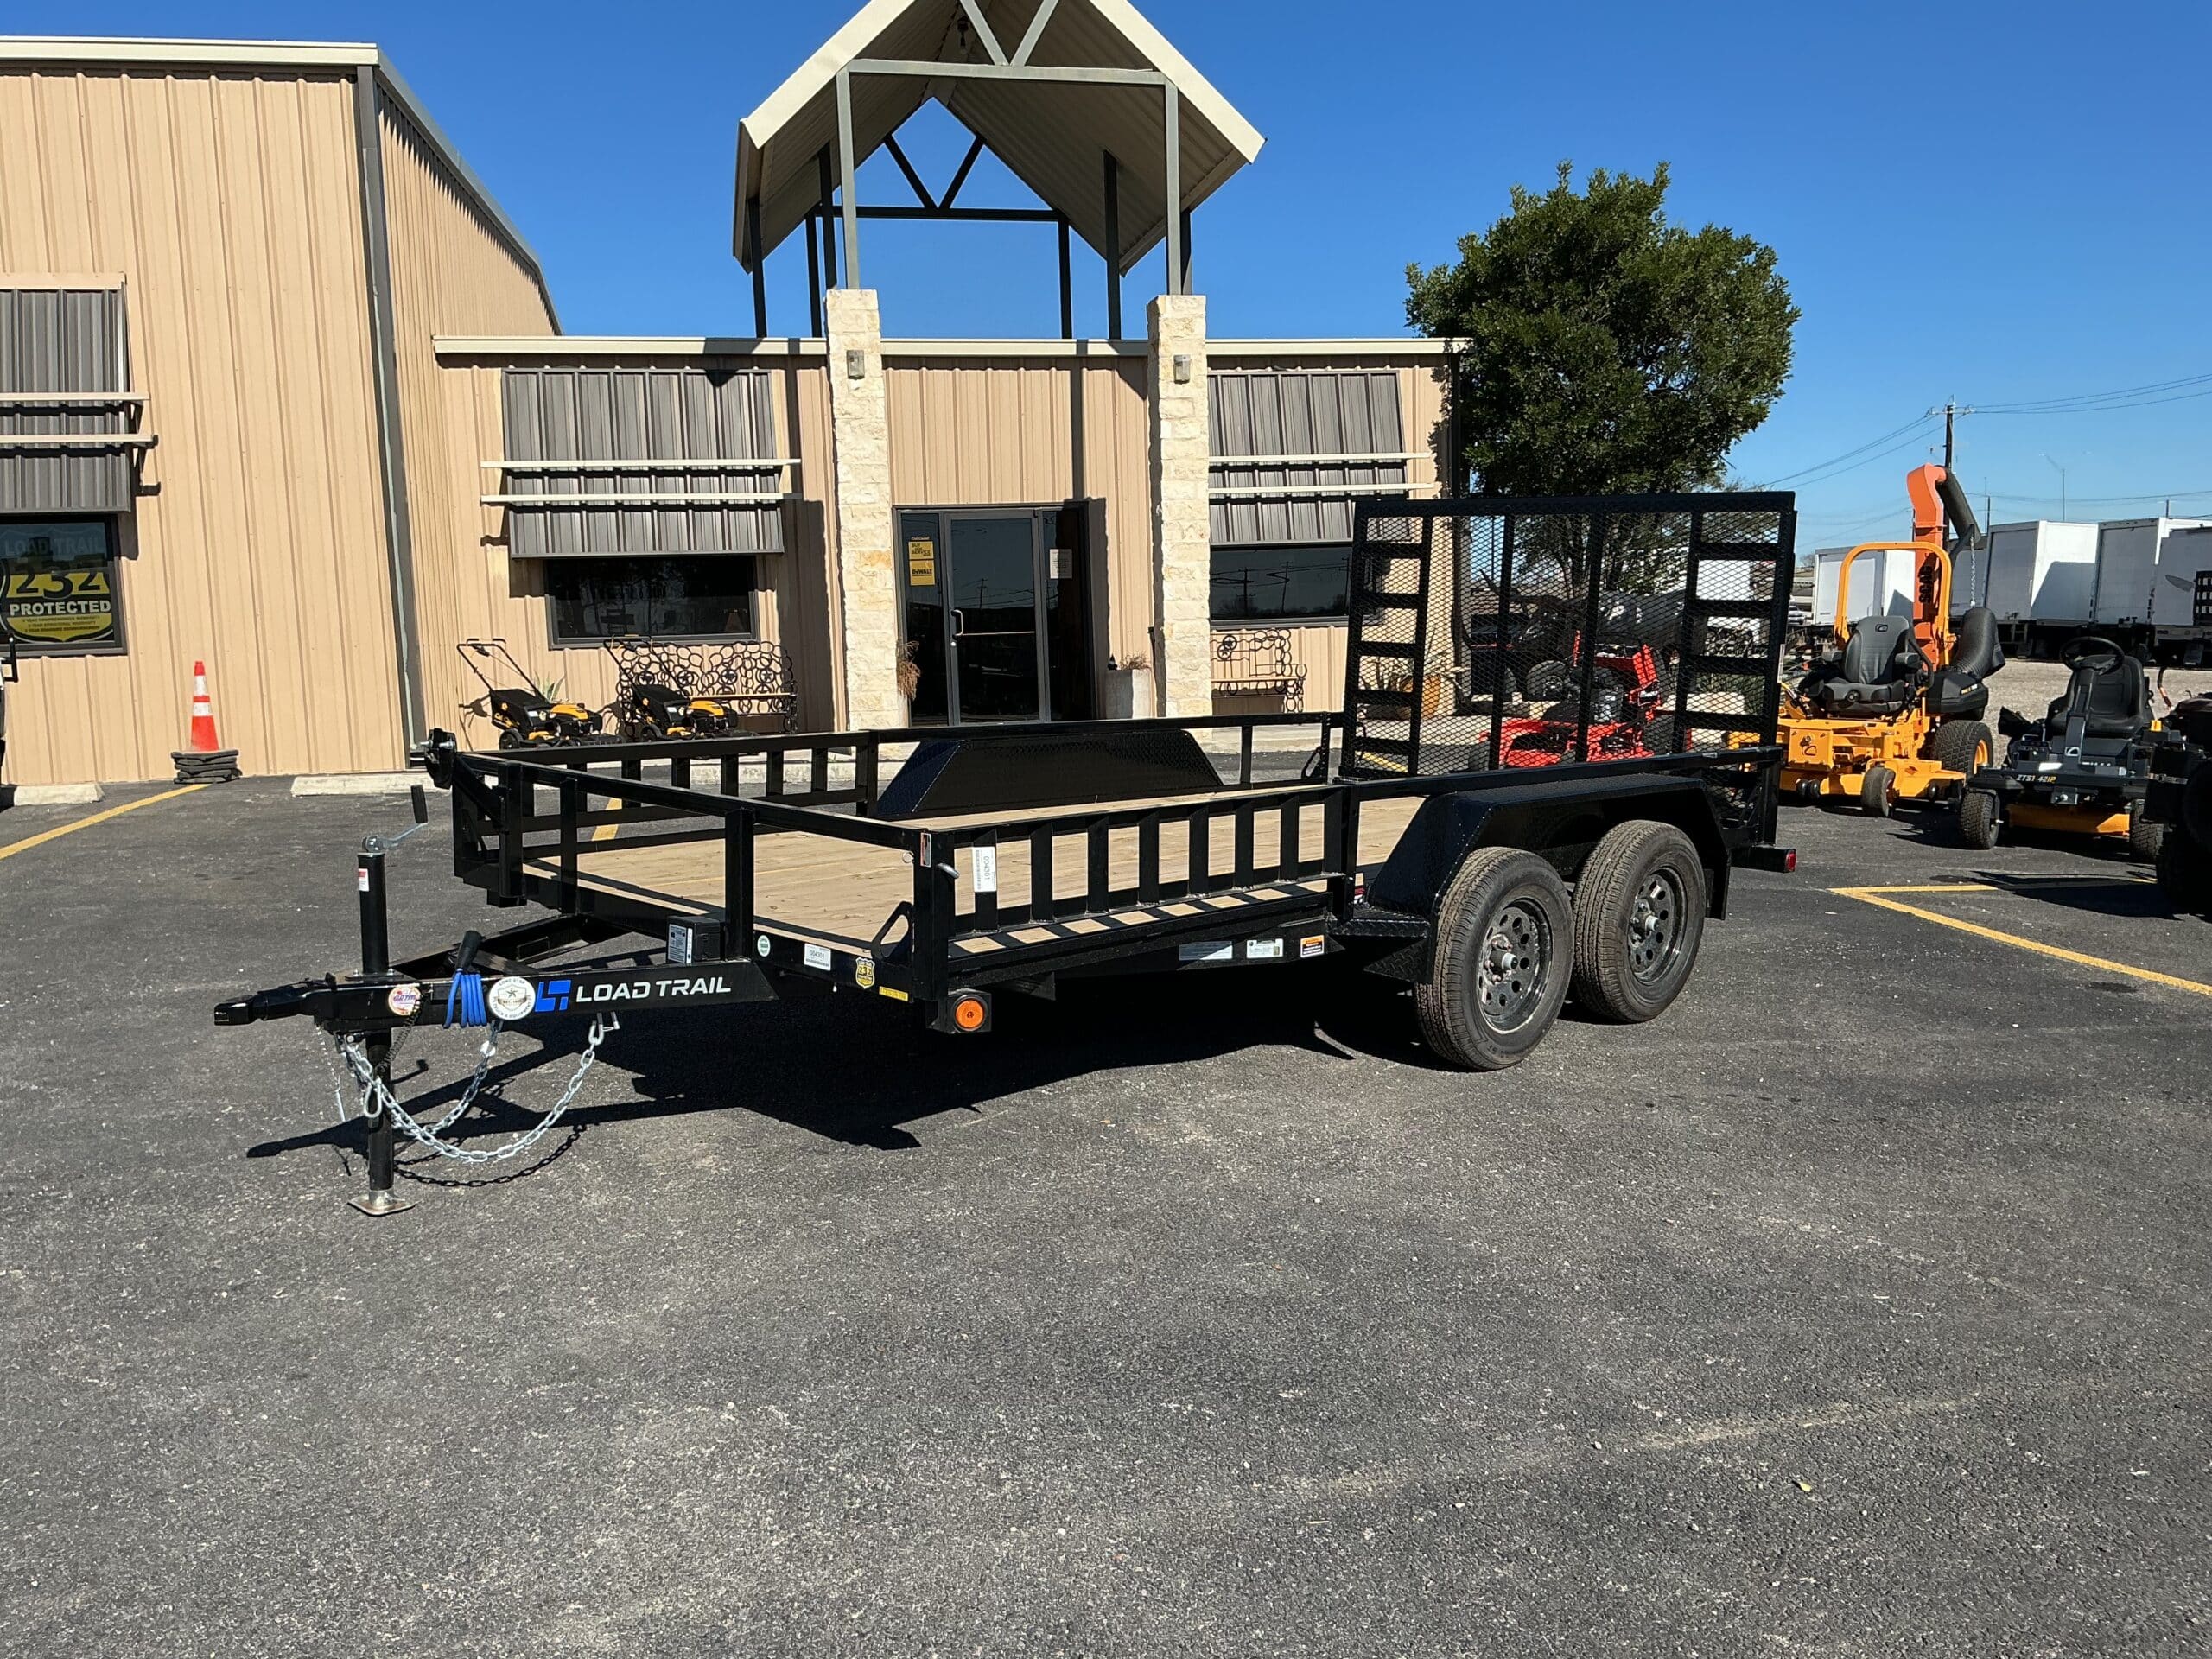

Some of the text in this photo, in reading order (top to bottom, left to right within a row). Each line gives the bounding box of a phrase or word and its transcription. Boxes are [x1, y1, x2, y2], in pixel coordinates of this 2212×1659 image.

[9, 600, 111, 616] PROTECTED
[575, 976, 732, 1003] LOAD TRAIL
